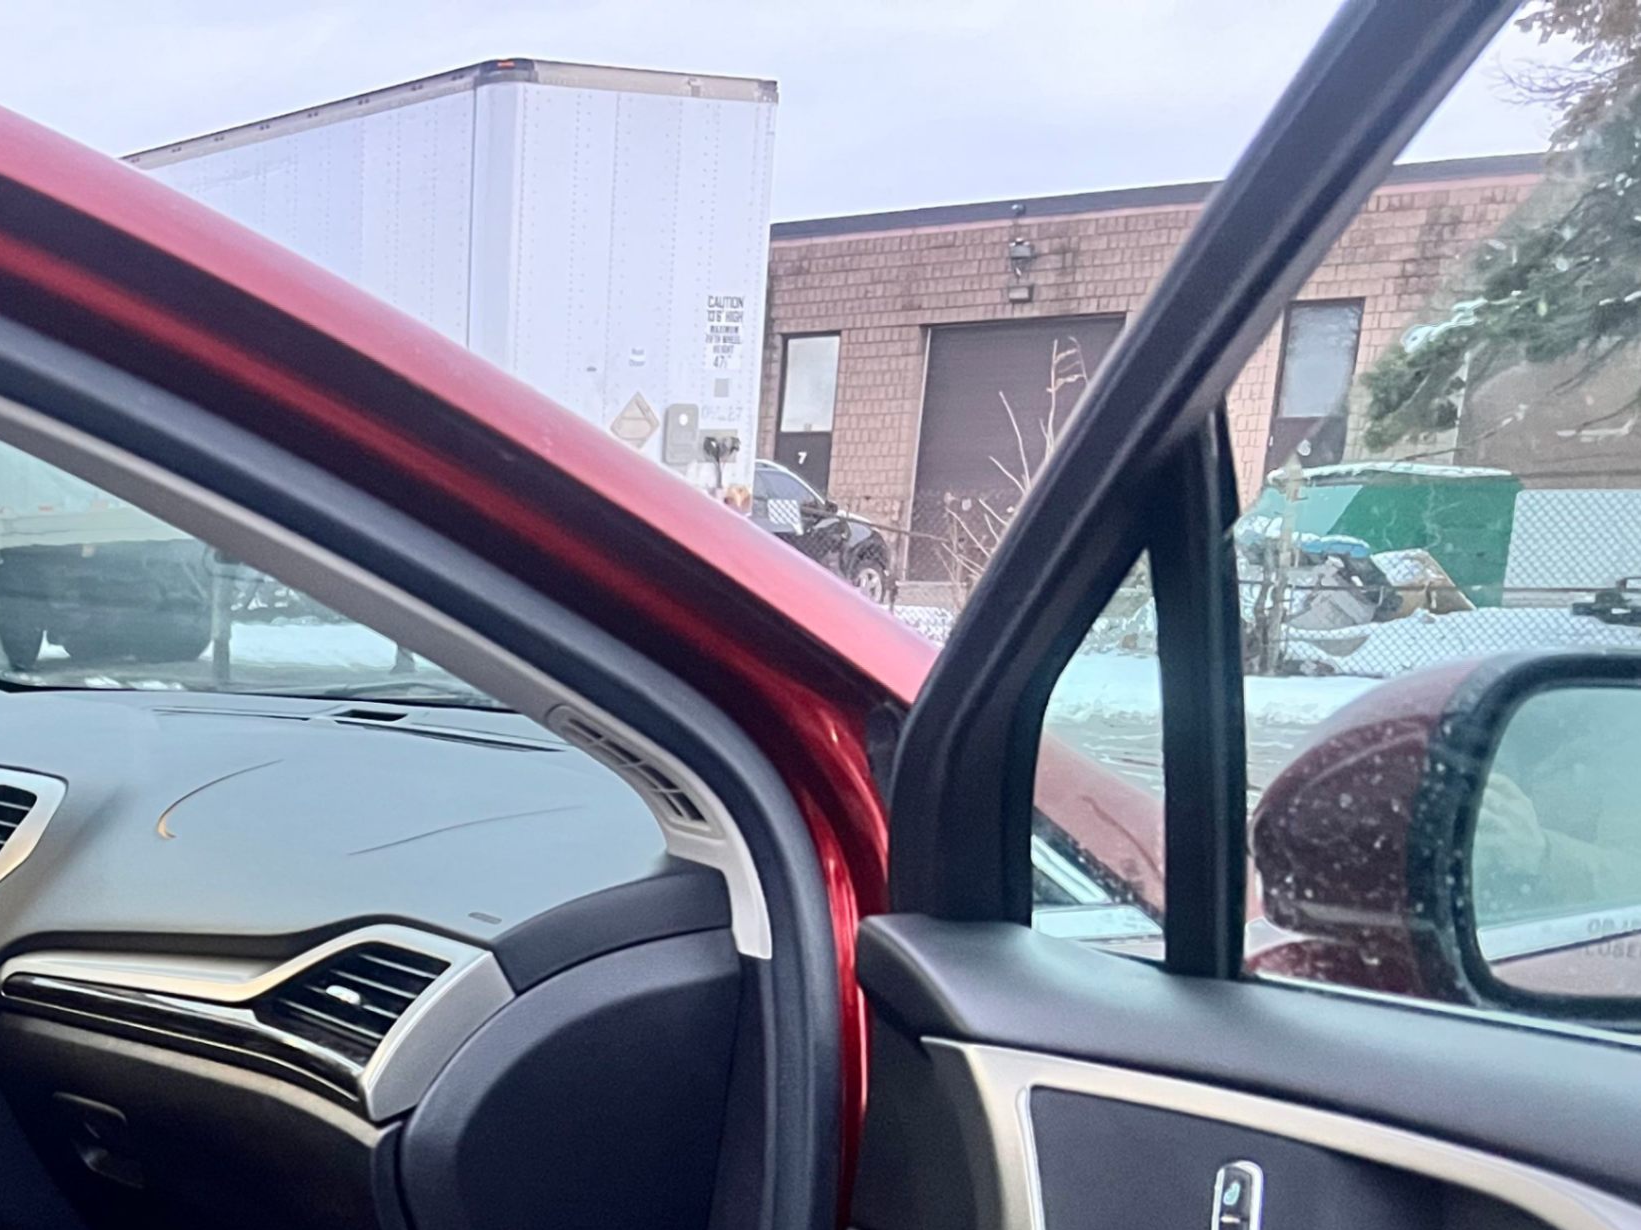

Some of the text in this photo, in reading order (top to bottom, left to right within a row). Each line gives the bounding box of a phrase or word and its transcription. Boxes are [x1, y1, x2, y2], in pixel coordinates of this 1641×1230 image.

[708, 295, 745, 309] CAUTION
[725, 310, 744, 324] HIGH
[798, 451, 807, 465] 7
